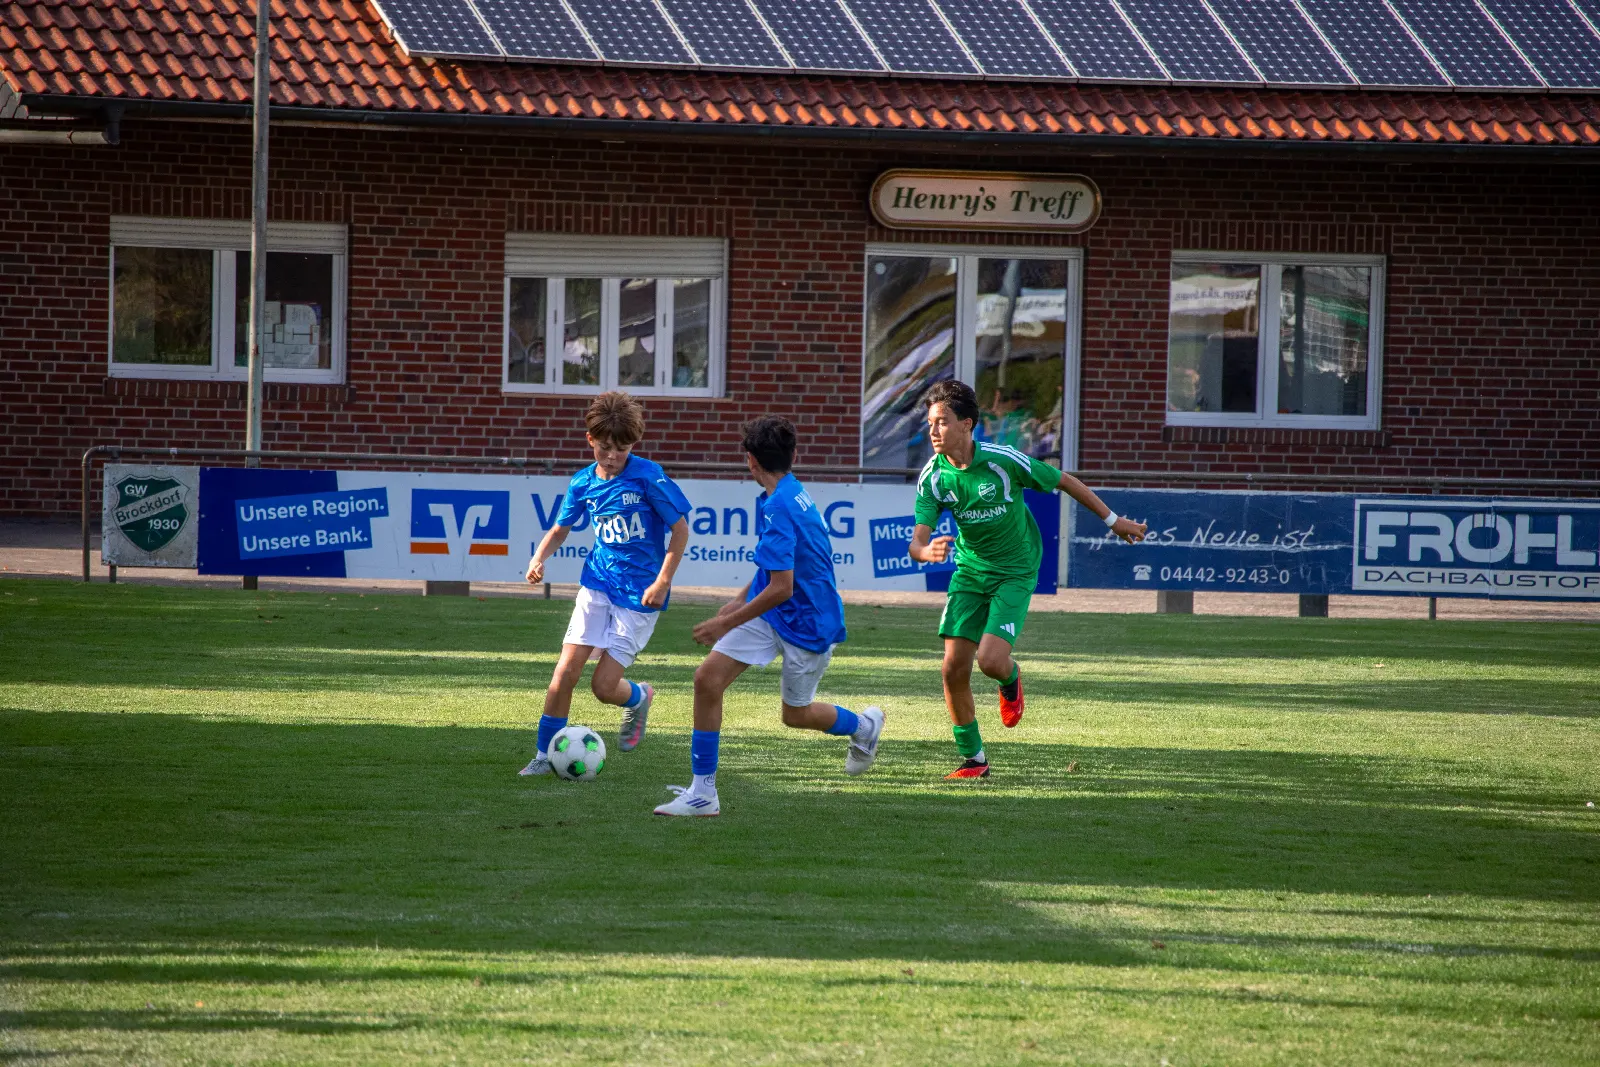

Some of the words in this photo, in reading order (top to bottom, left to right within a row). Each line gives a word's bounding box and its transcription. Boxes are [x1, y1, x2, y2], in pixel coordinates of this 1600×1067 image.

[892, 186, 997, 217] Henry's
[1010, 190, 1084, 220] Treff
[124, 484, 148, 495] GW
[115, 490, 181, 523] Brockdorf
[240, 503, 308, 522] Unsere
[312, 496, 385, 518] Region.
[148, 518, 180, 530] 1930
[243, 533, 311, 552] Unsere
[316, 526, 368, 547] Bank.
[1160, 565, 1290, 584] 04442-9243-0
